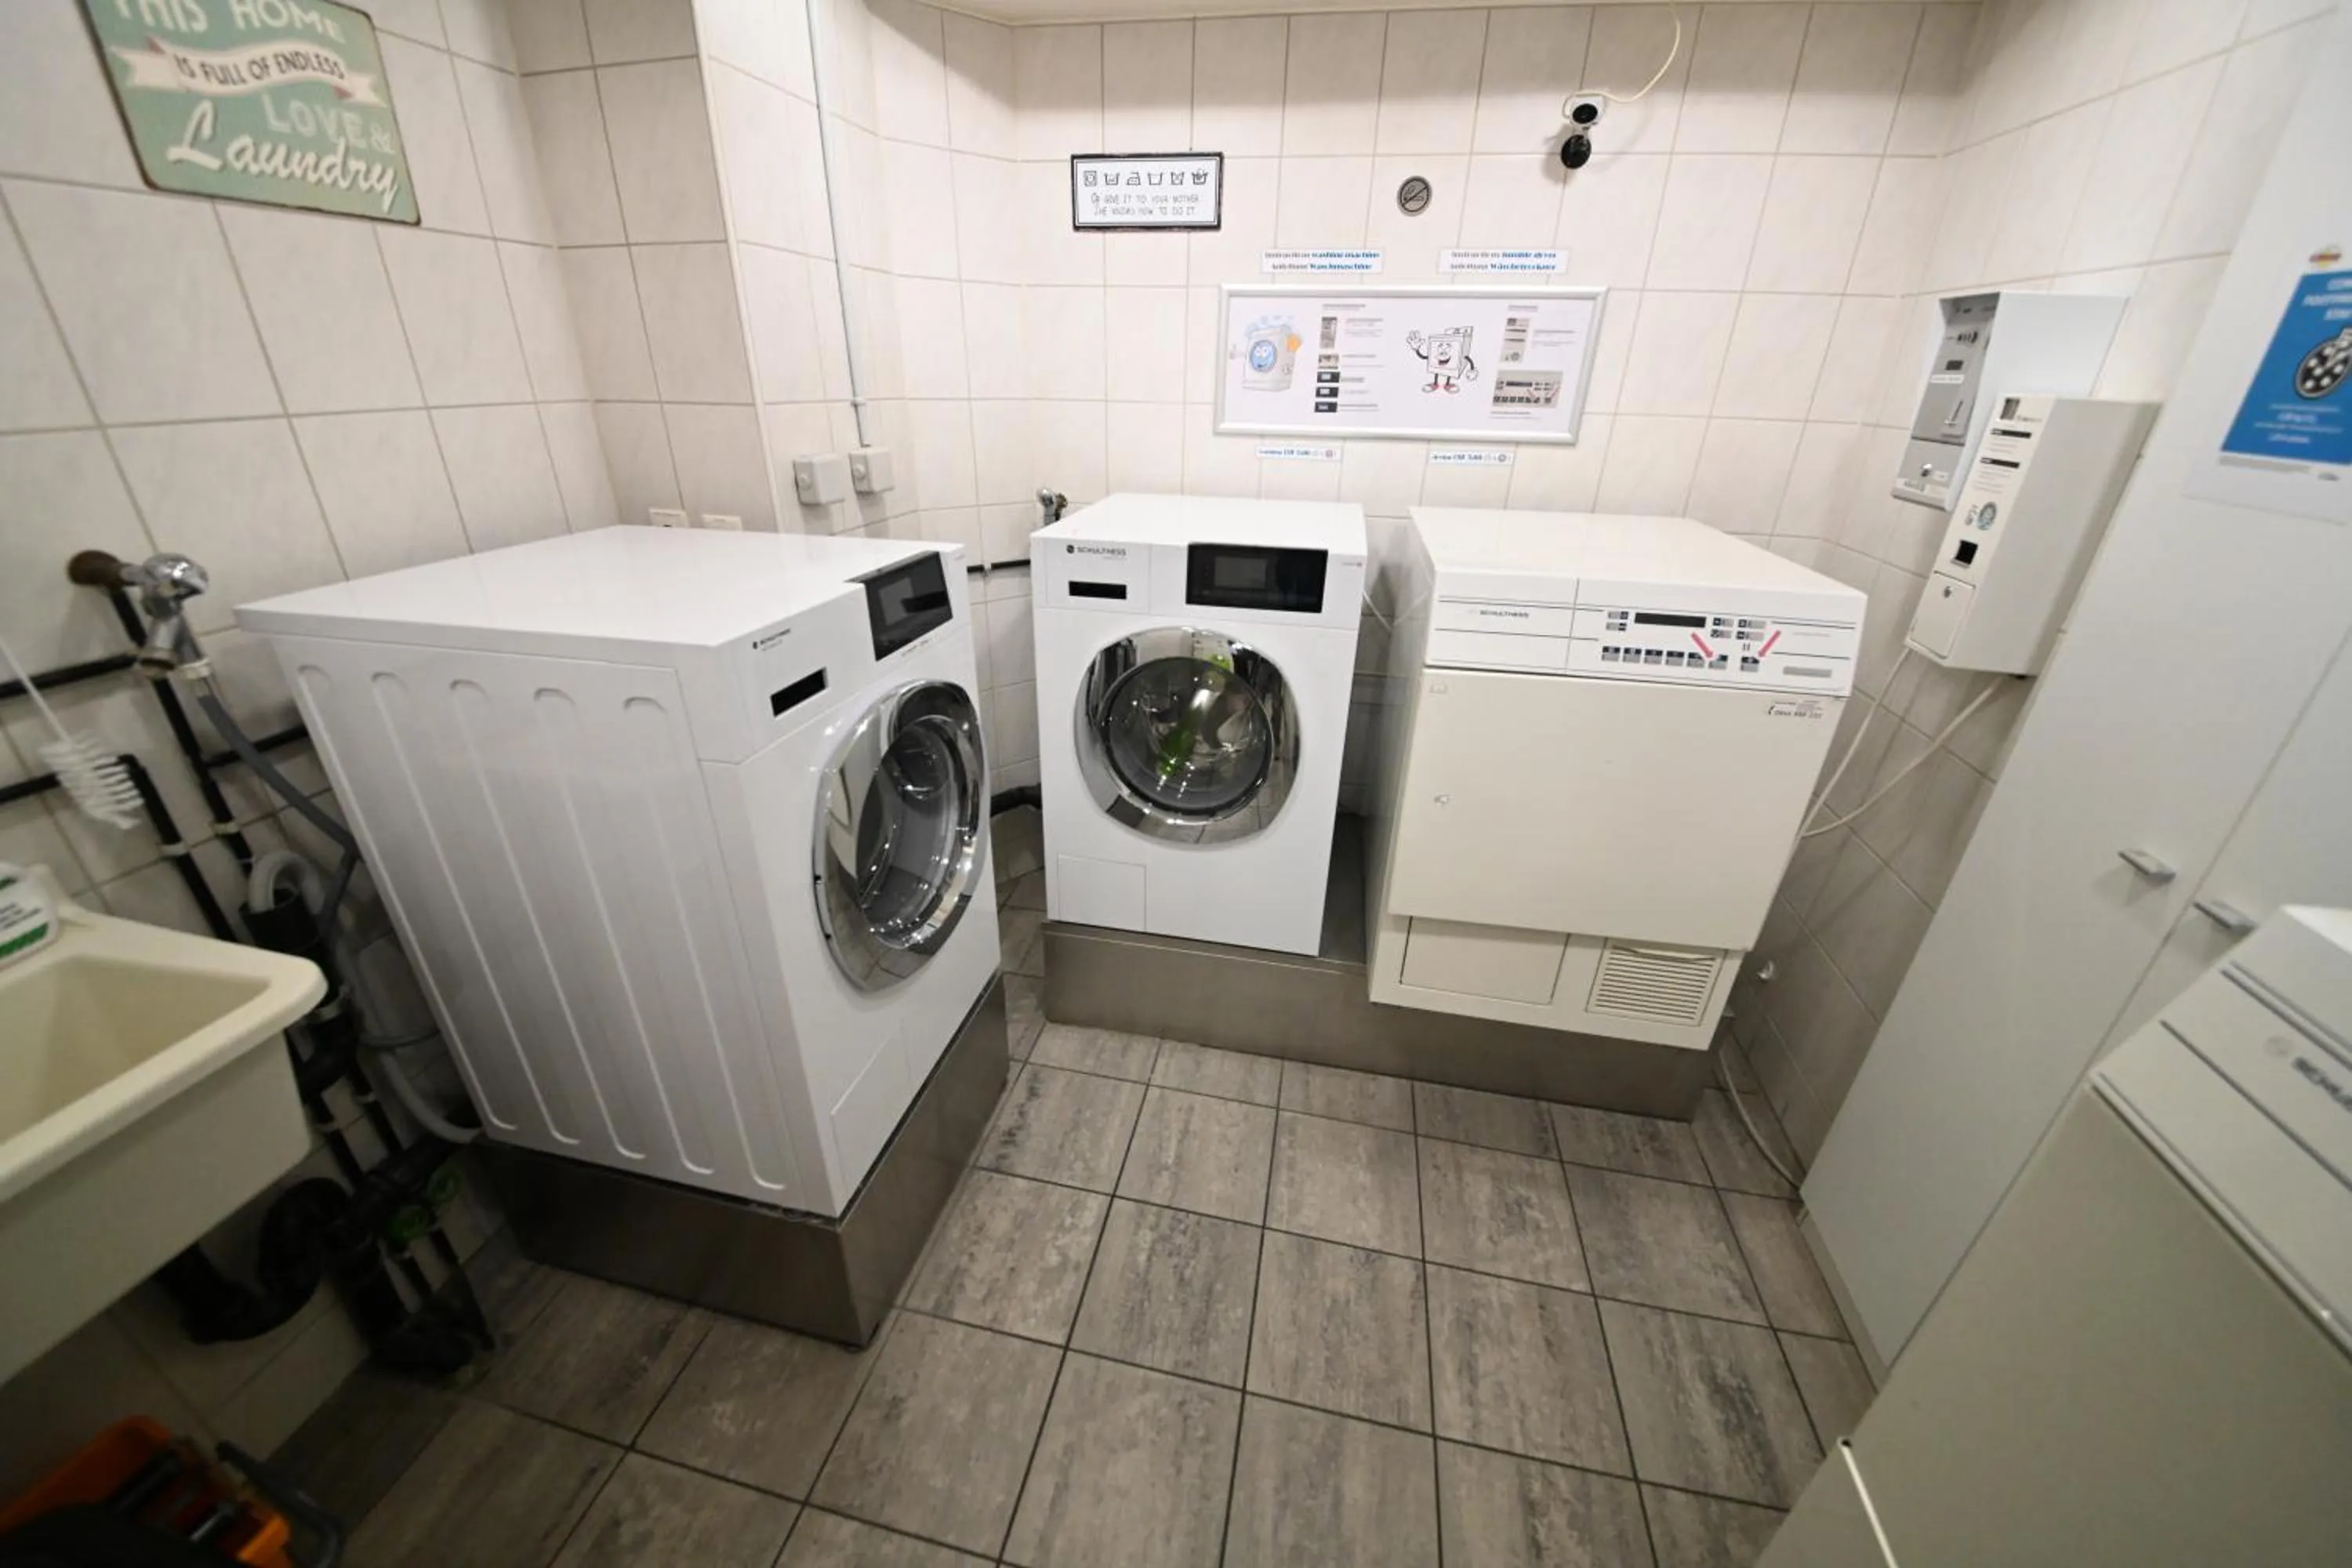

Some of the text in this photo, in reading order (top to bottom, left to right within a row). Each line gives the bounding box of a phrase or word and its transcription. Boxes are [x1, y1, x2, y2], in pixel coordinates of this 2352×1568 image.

[229, 0, 347, 44] HOME
[173, 50, 345, 85] IS FULL OF ENDLESS
[262, 93, 368, 149] LOVE
[165, 99, 398, 213] Laundry
